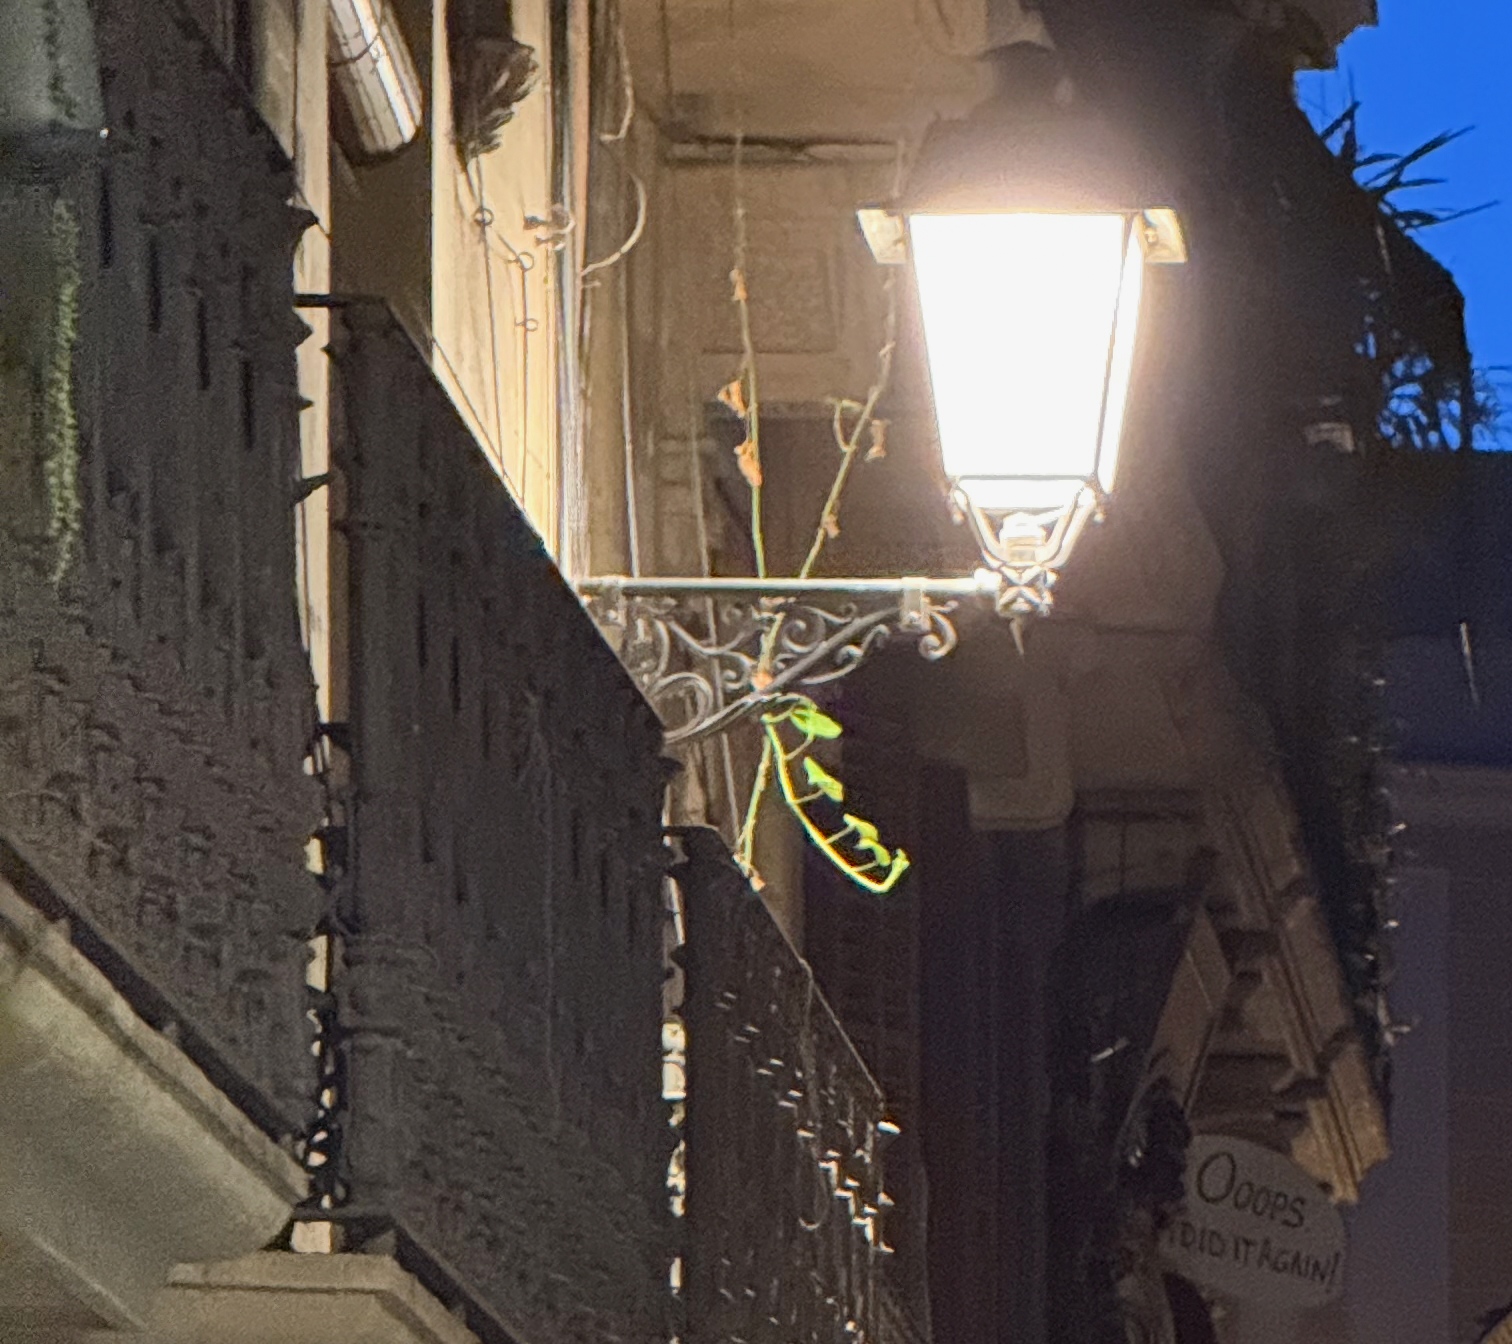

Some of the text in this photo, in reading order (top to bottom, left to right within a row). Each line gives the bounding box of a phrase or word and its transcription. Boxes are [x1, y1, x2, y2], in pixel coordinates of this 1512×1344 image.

[1179, 1221, 1226, 1258] DID
[1233, 1235, 1255, 1266] IT
[1257, 1237, 1342, 1294] AGAIN!
